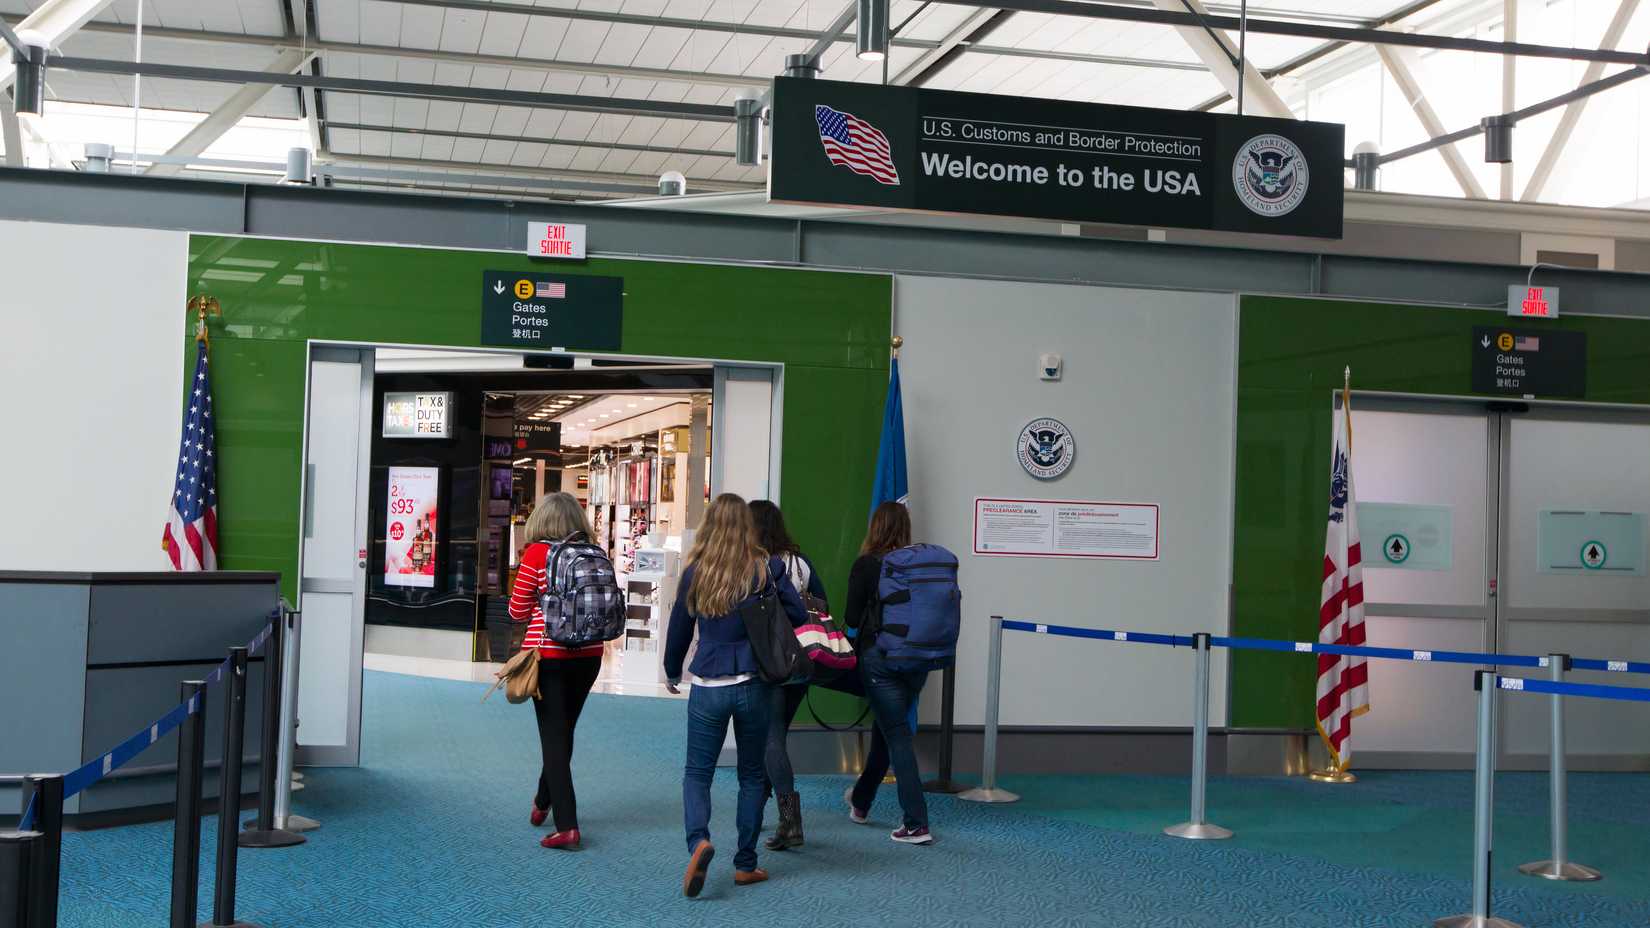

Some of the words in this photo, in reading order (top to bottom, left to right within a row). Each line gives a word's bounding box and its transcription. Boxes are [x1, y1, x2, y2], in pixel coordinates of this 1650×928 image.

[923, 119, 956, 137] U.S.
[961, 122, 1031, 143] Customs
[1035, 131, 1064, 145] and
[1069, 132, 1121, 150] Border
[1125, 136, 1202, 156] Protection
[921, 151, 1049, 185] Welcome
[1055, 163, 1084, 187] to
[1091, 166, 1135, 191] the
[1144, 169, 1201, 196] USA
[547, 225, 566, 240] EXIT
[540, 240, 573, 256] SORTIE
[518, 283, 529, 296] E
[1527, 287, 1544, 301] EXIT
[512, 301, 546, 314] Gates
[1521, 301, 1549, 317] SORTIE
[511, 314, 549, 327] Portes
[1501, 336, 1510, 348] E
[1496, 354, 1524, 365] Gates
[1496, 366, 1526, 377] Portes
[417, 409, 443, 420] DUTY
[417, 422, 442, 433] FREE
[519, 424, 533, 432] pay
[534, 424, 551, 432] here
[391, 485, 398, 497] 2
[391, 498, 414, 515] $93
